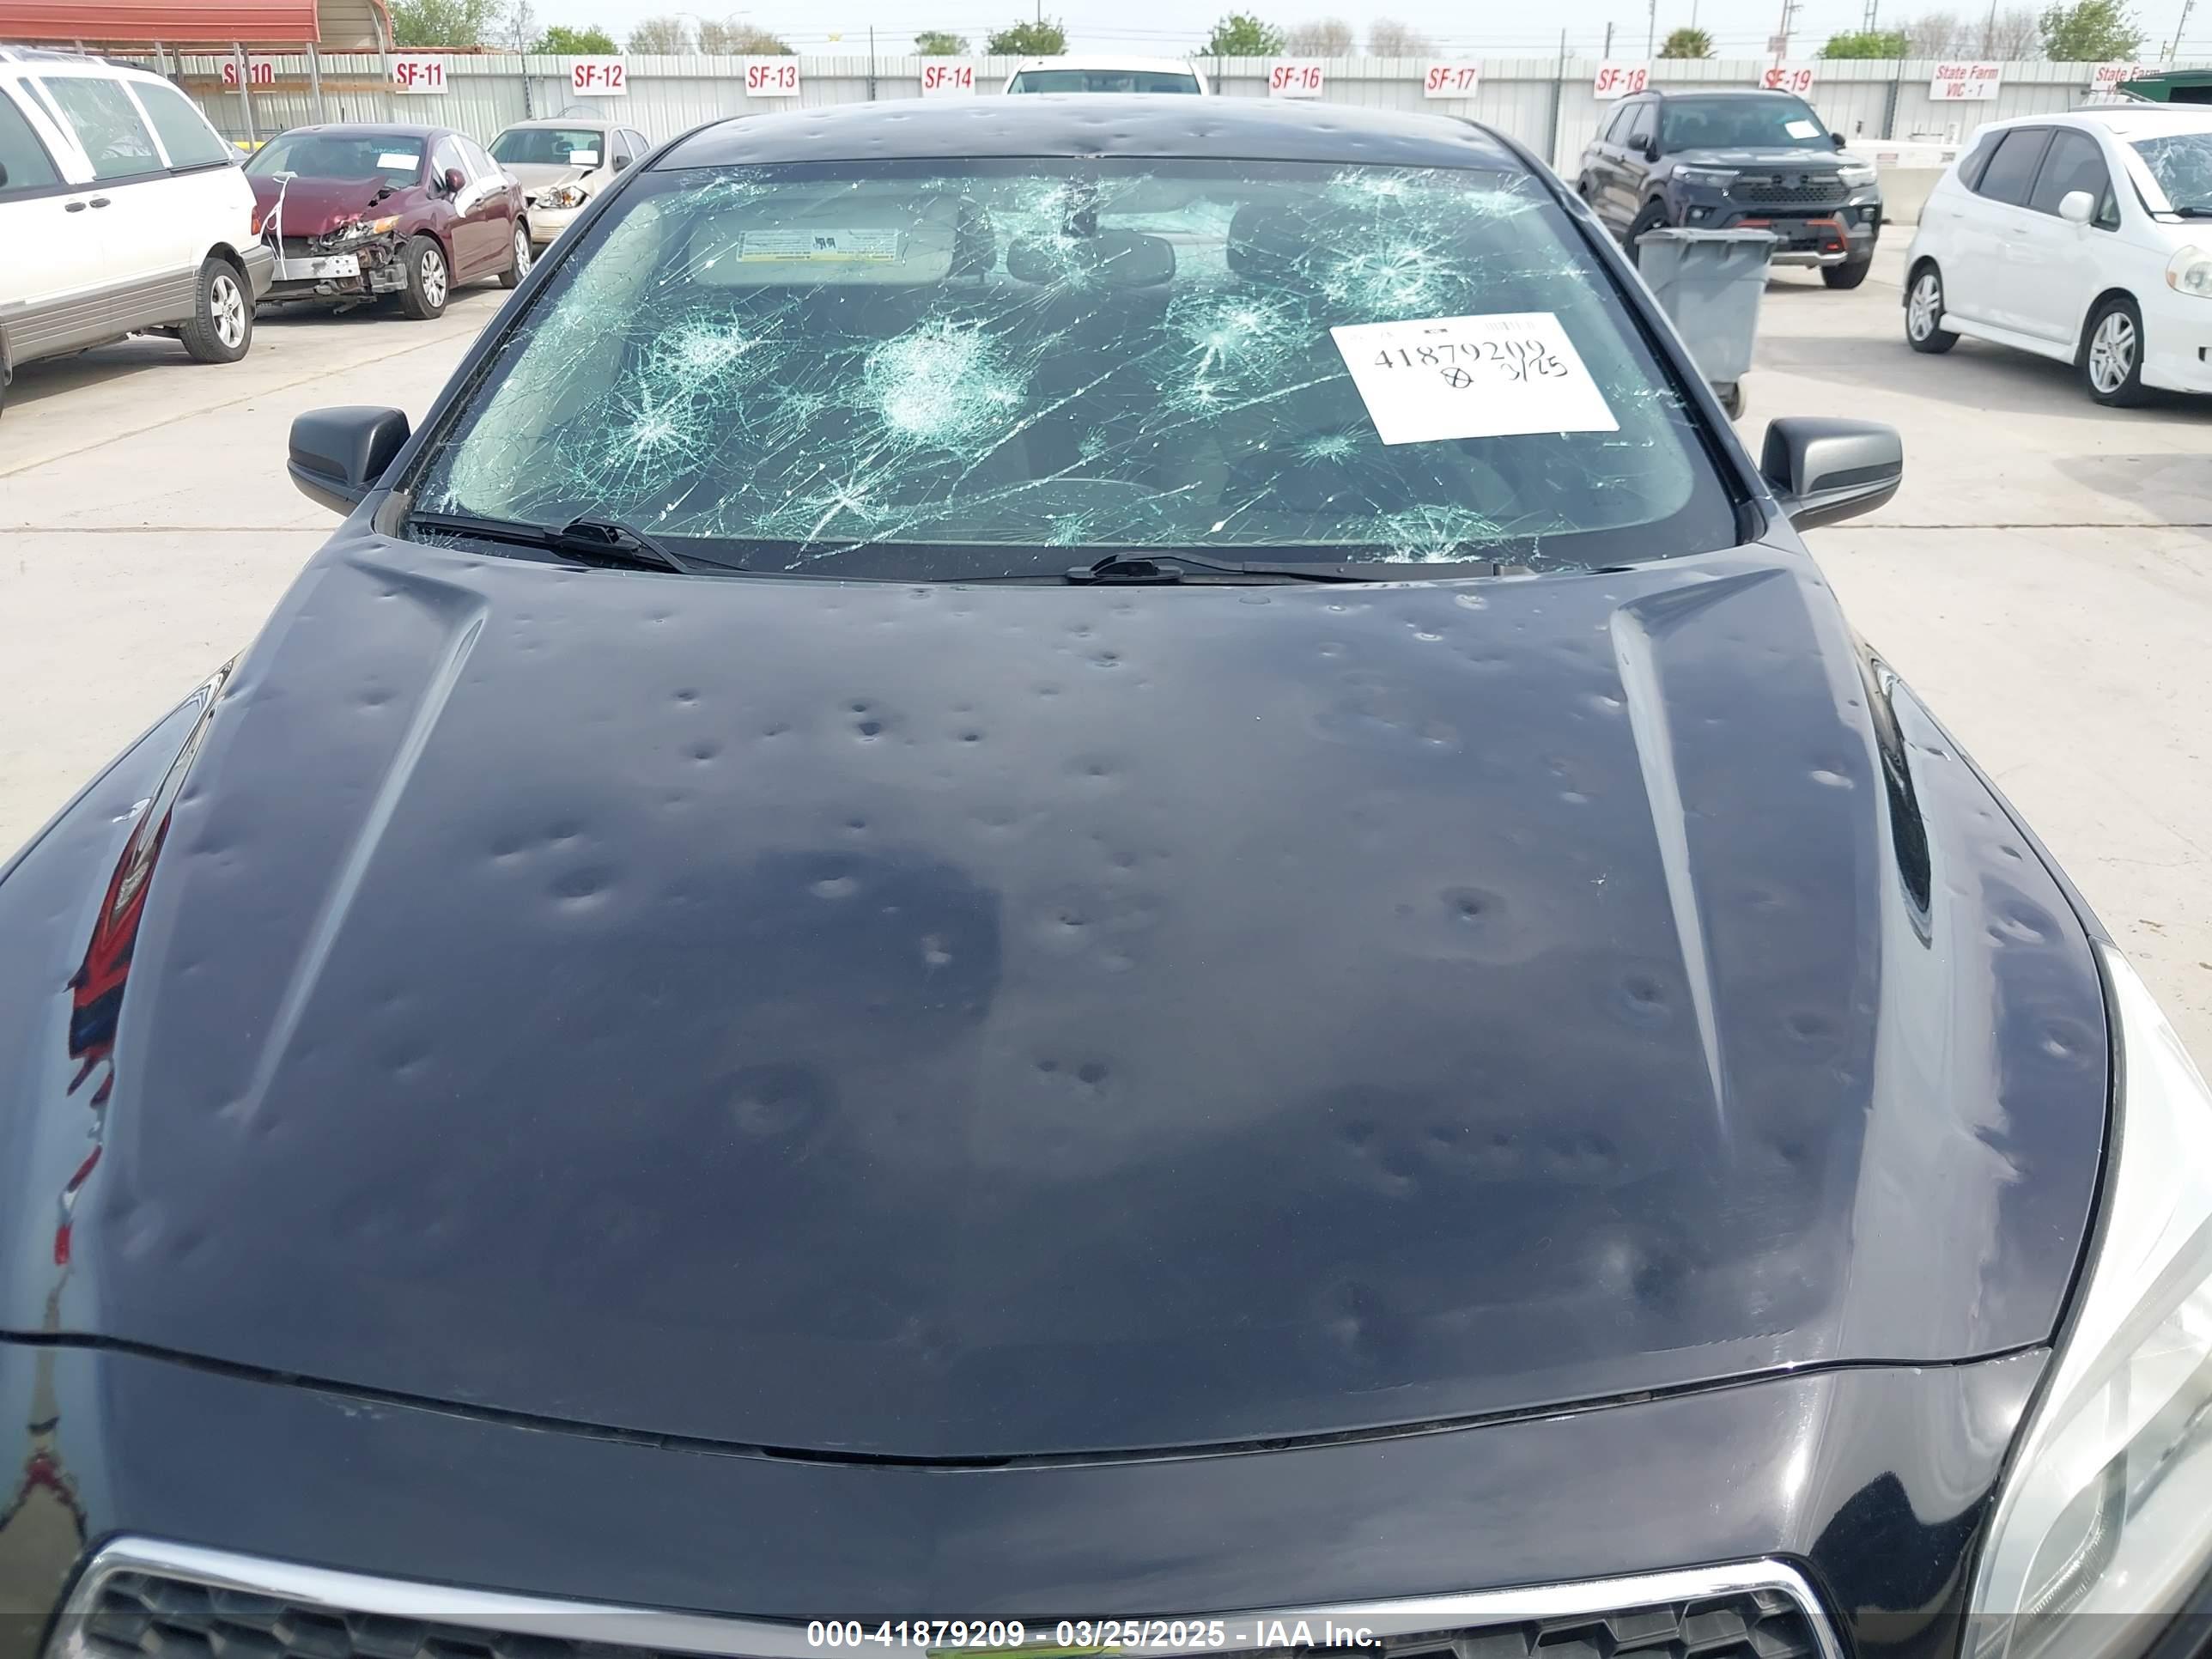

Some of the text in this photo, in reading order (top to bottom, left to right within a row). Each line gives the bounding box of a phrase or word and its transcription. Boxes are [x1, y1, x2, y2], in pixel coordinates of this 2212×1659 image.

[224, 63, 272, 83] S10
[397, 63, 441, 86] SF-11
[574, 64, 623, 87] SF-12
[748, 65, 796, 88] SF-13
[925, 67, 971, 88] SF-14
[1273, 67, 1321, 89] SF-16
[1428, 68, 1475, 90] SF-17
[1598, 69, 1646, 92] SF-18
[1765, 69, 1812, 91] SF-19
[1936, 65, 1999, 79] State Farm
[2096, 67, 2127, 81] State
[1947, 82, 1966, 96] VIC
[1978, 83, 1984, 96] 1
[1374, 340, 1545, 368] 41879209
